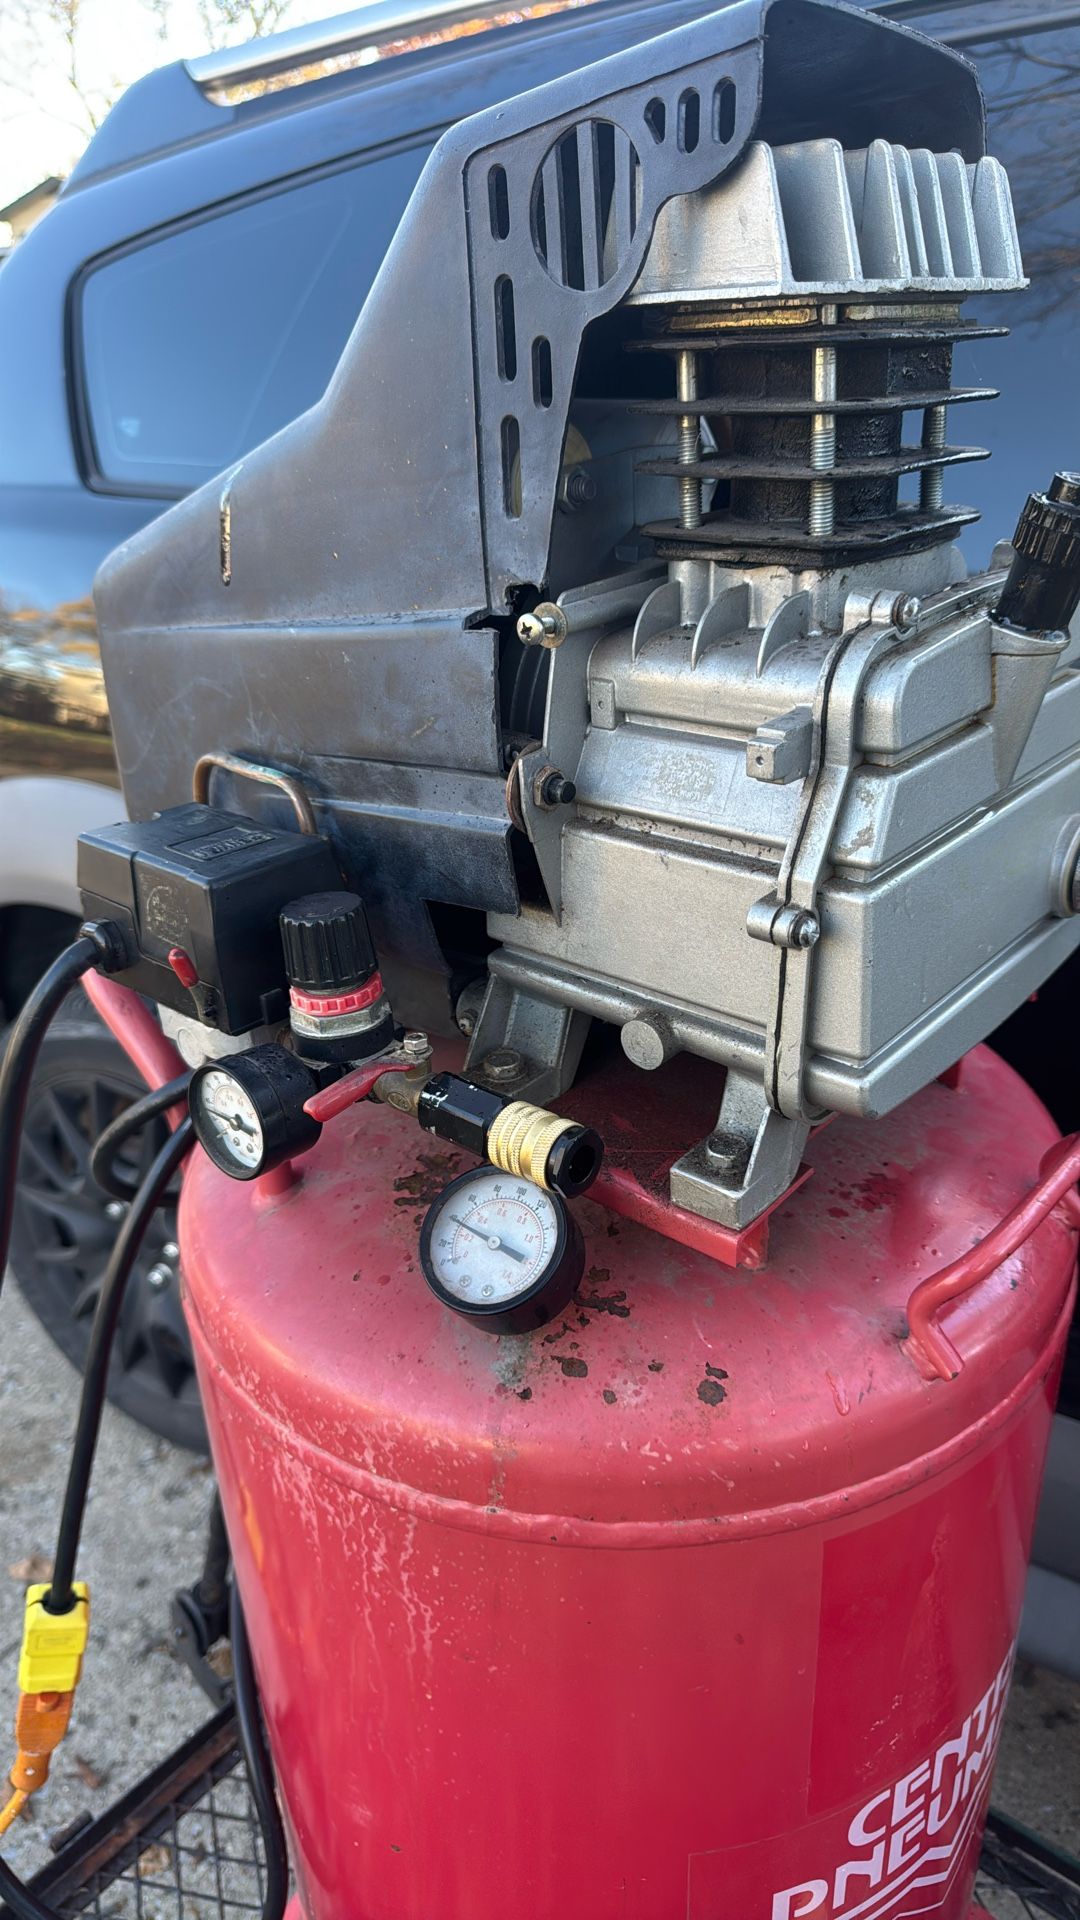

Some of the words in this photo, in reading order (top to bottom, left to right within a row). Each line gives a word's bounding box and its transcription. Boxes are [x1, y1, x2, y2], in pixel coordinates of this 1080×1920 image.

[516, 1186, 528, 1196] 100
[537, 1199, 547, 1209] 120
[438, 1238, 447, 1248] 20
